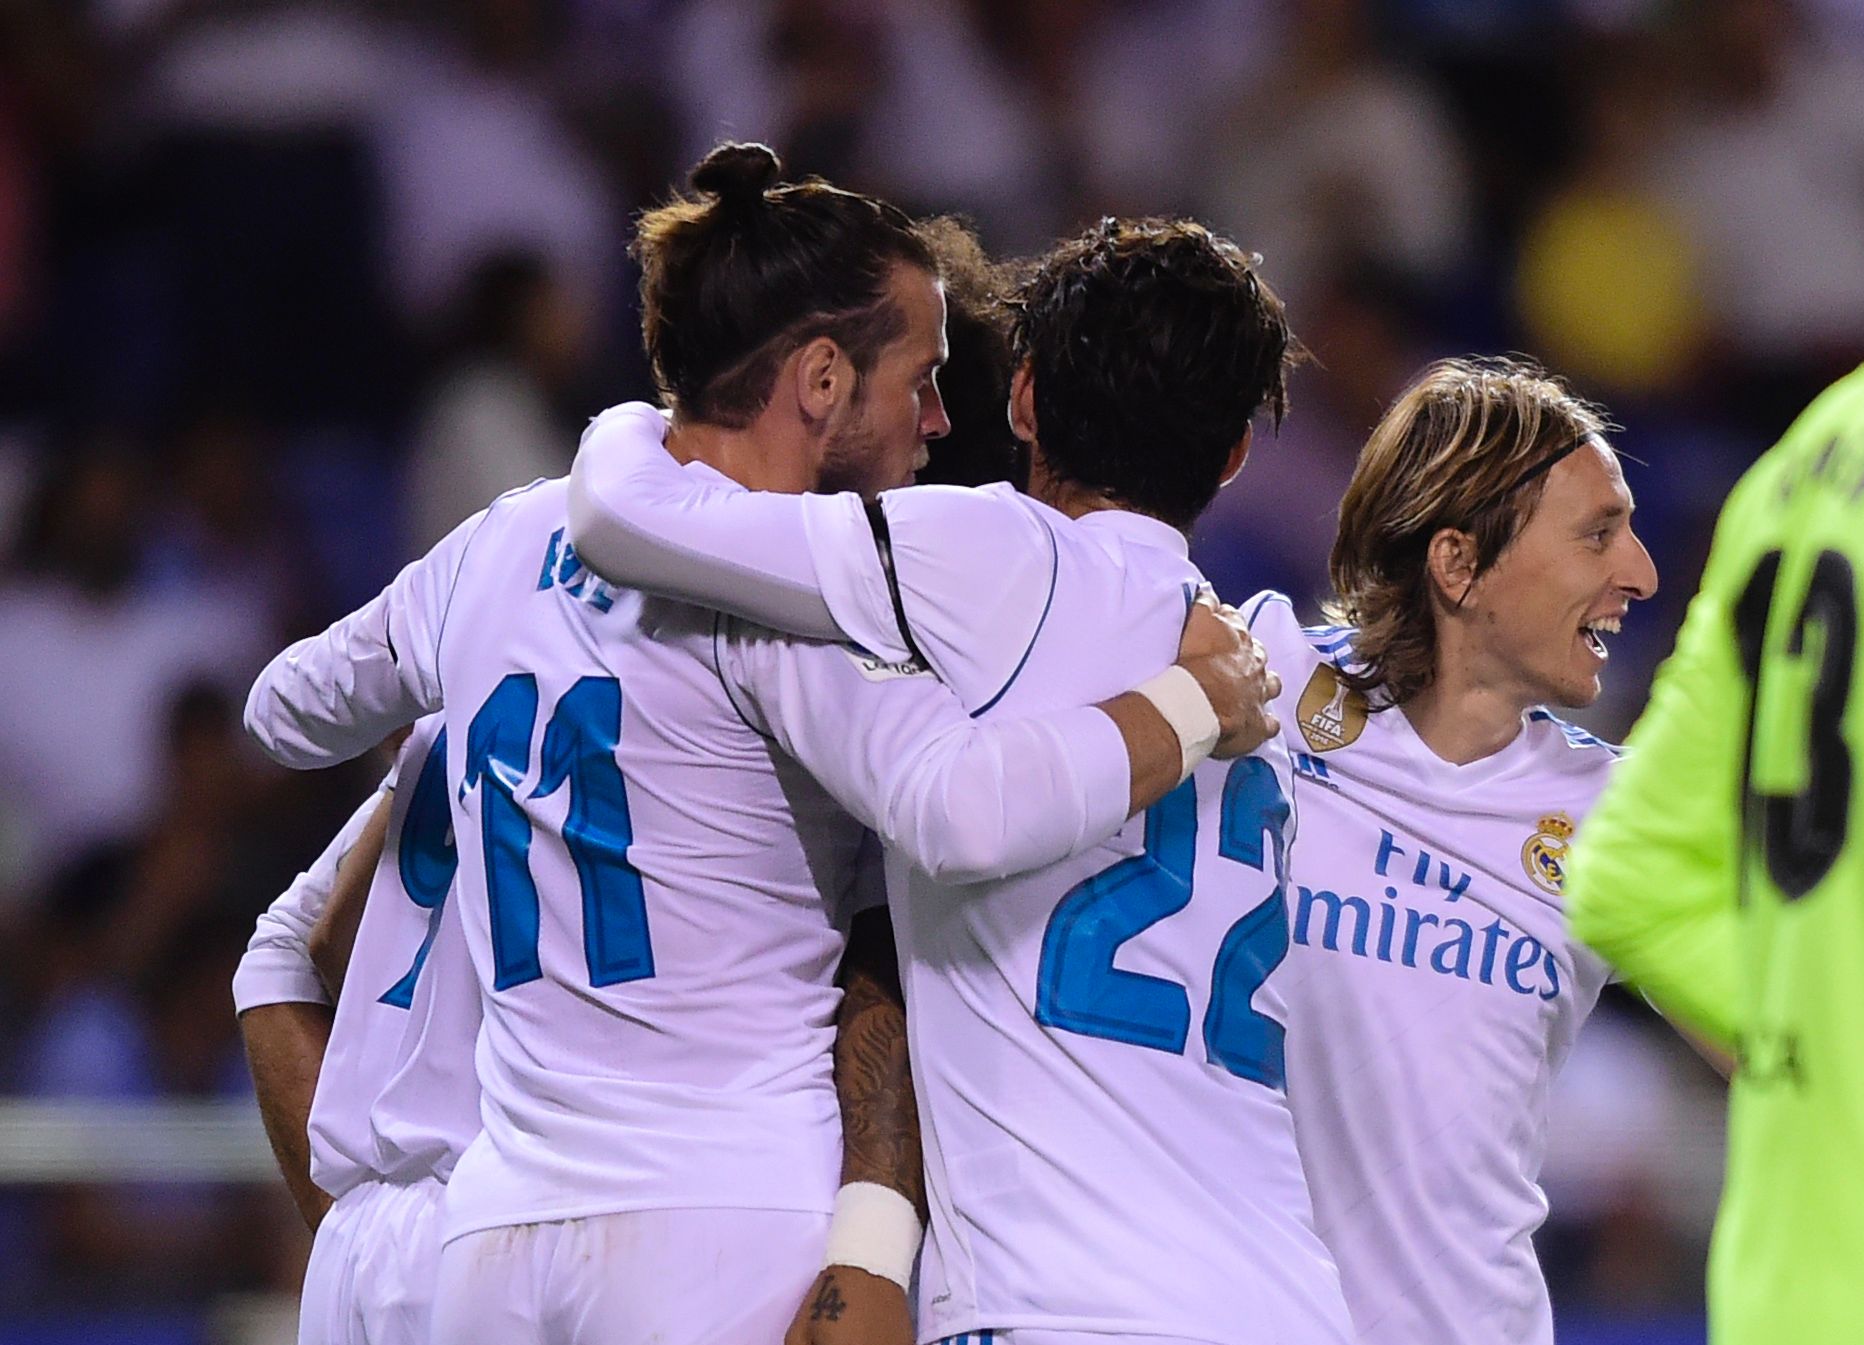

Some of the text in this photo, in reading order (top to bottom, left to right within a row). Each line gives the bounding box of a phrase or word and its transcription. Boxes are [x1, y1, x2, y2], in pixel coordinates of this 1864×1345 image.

[459, 672, 656, 991] 11
[1310, 713, 1342, 737] FIFA
[1732, 548, 1857, 906] 13
[1035, 756, 1291, 1098] 22
[1294, 884, 1560, 1002] mirates
[1374, 828, 1471, 903] Fly
